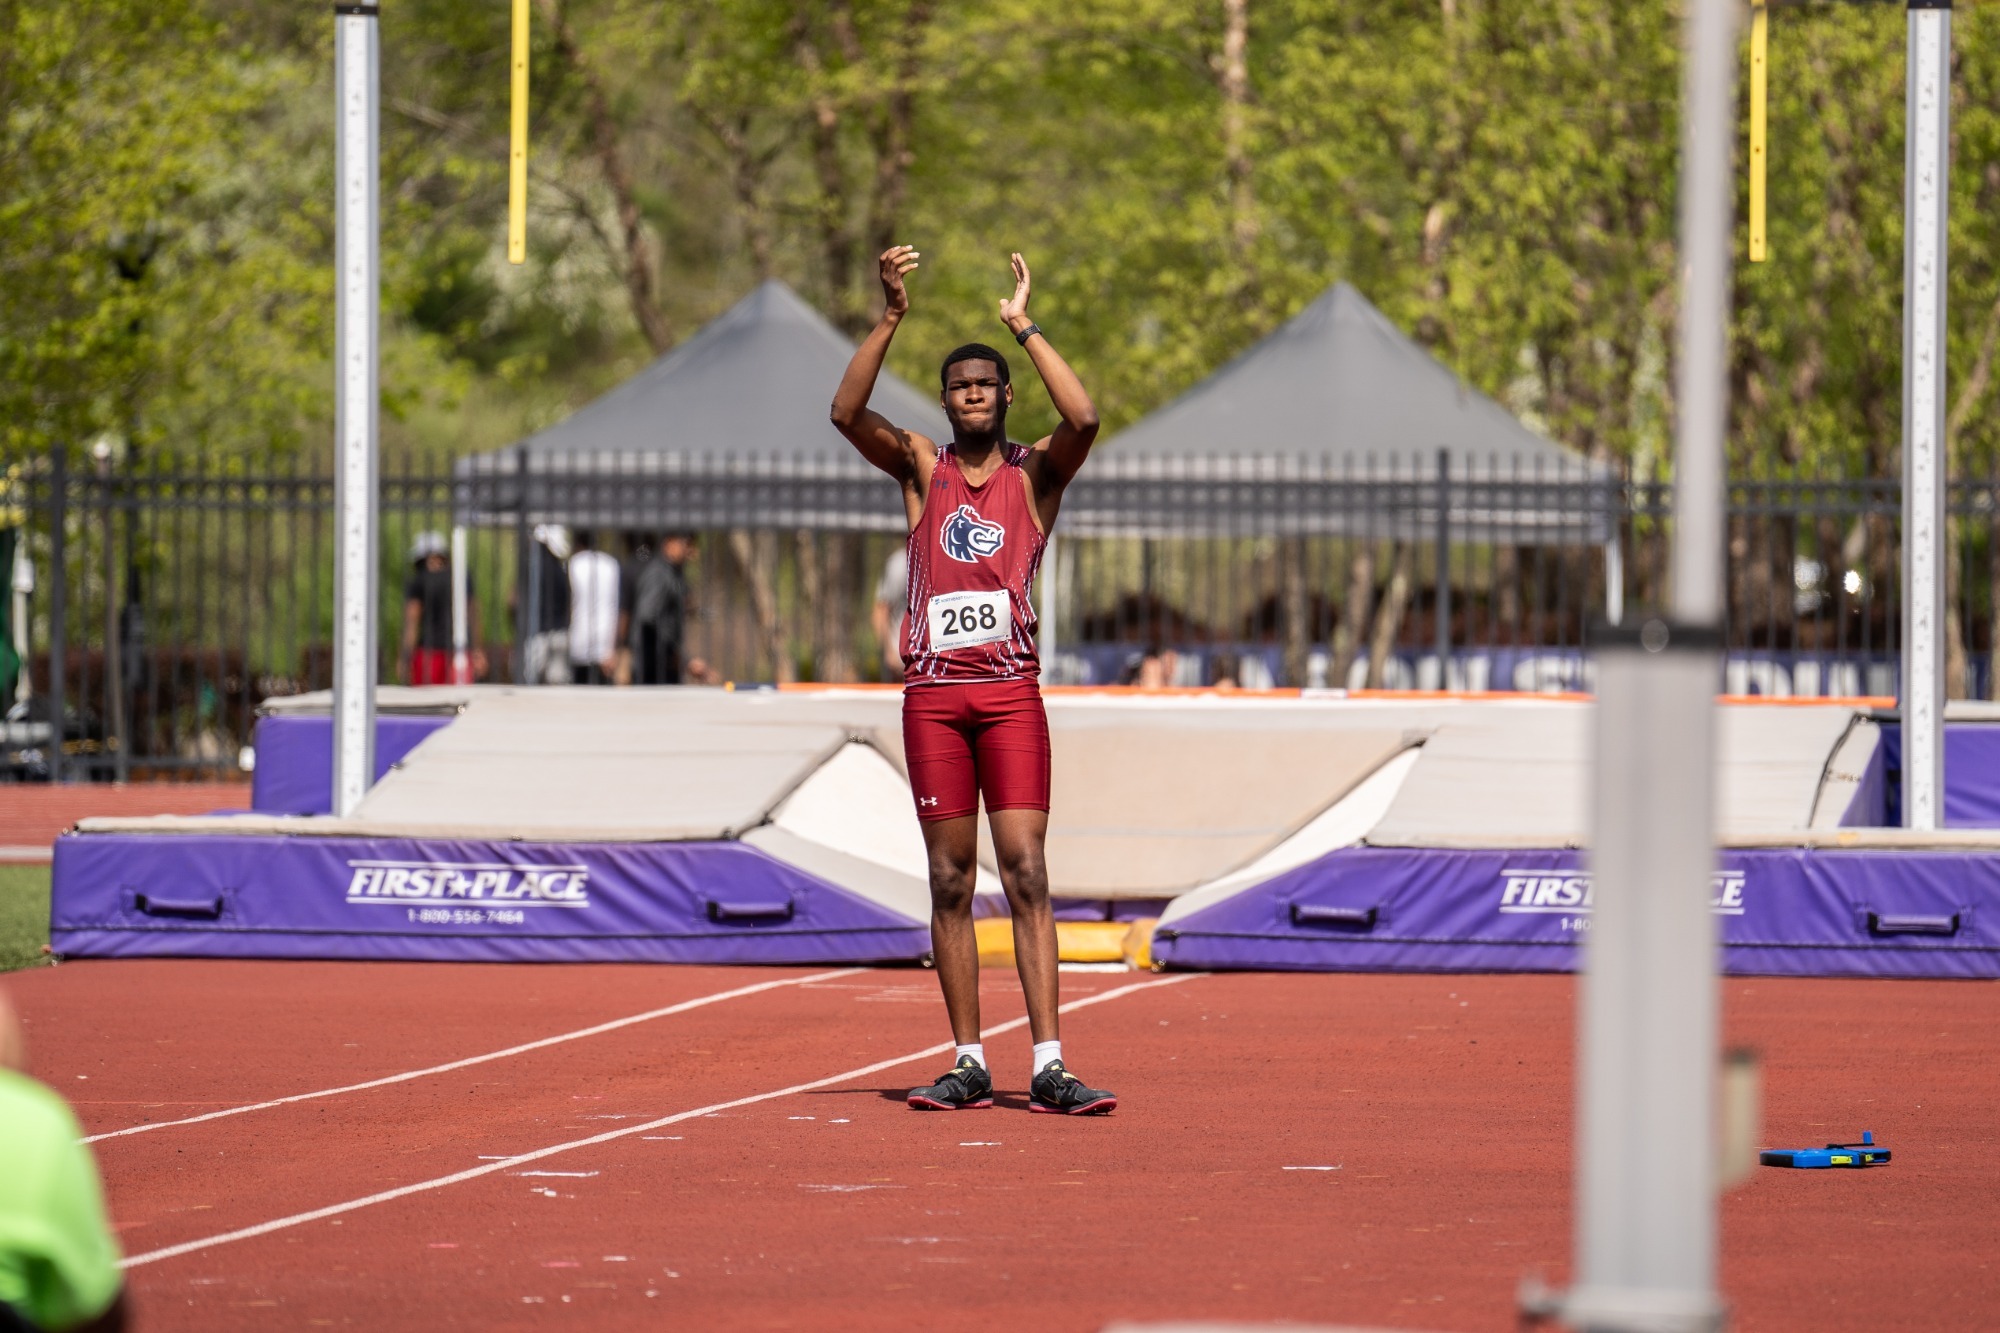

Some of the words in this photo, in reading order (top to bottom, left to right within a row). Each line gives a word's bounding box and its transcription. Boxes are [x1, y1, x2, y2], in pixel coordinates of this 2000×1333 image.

[941, 603, 997, 636] 268
[347, 867, 451, 897] FIRST
[469, 871, 589, 900] PLACE
